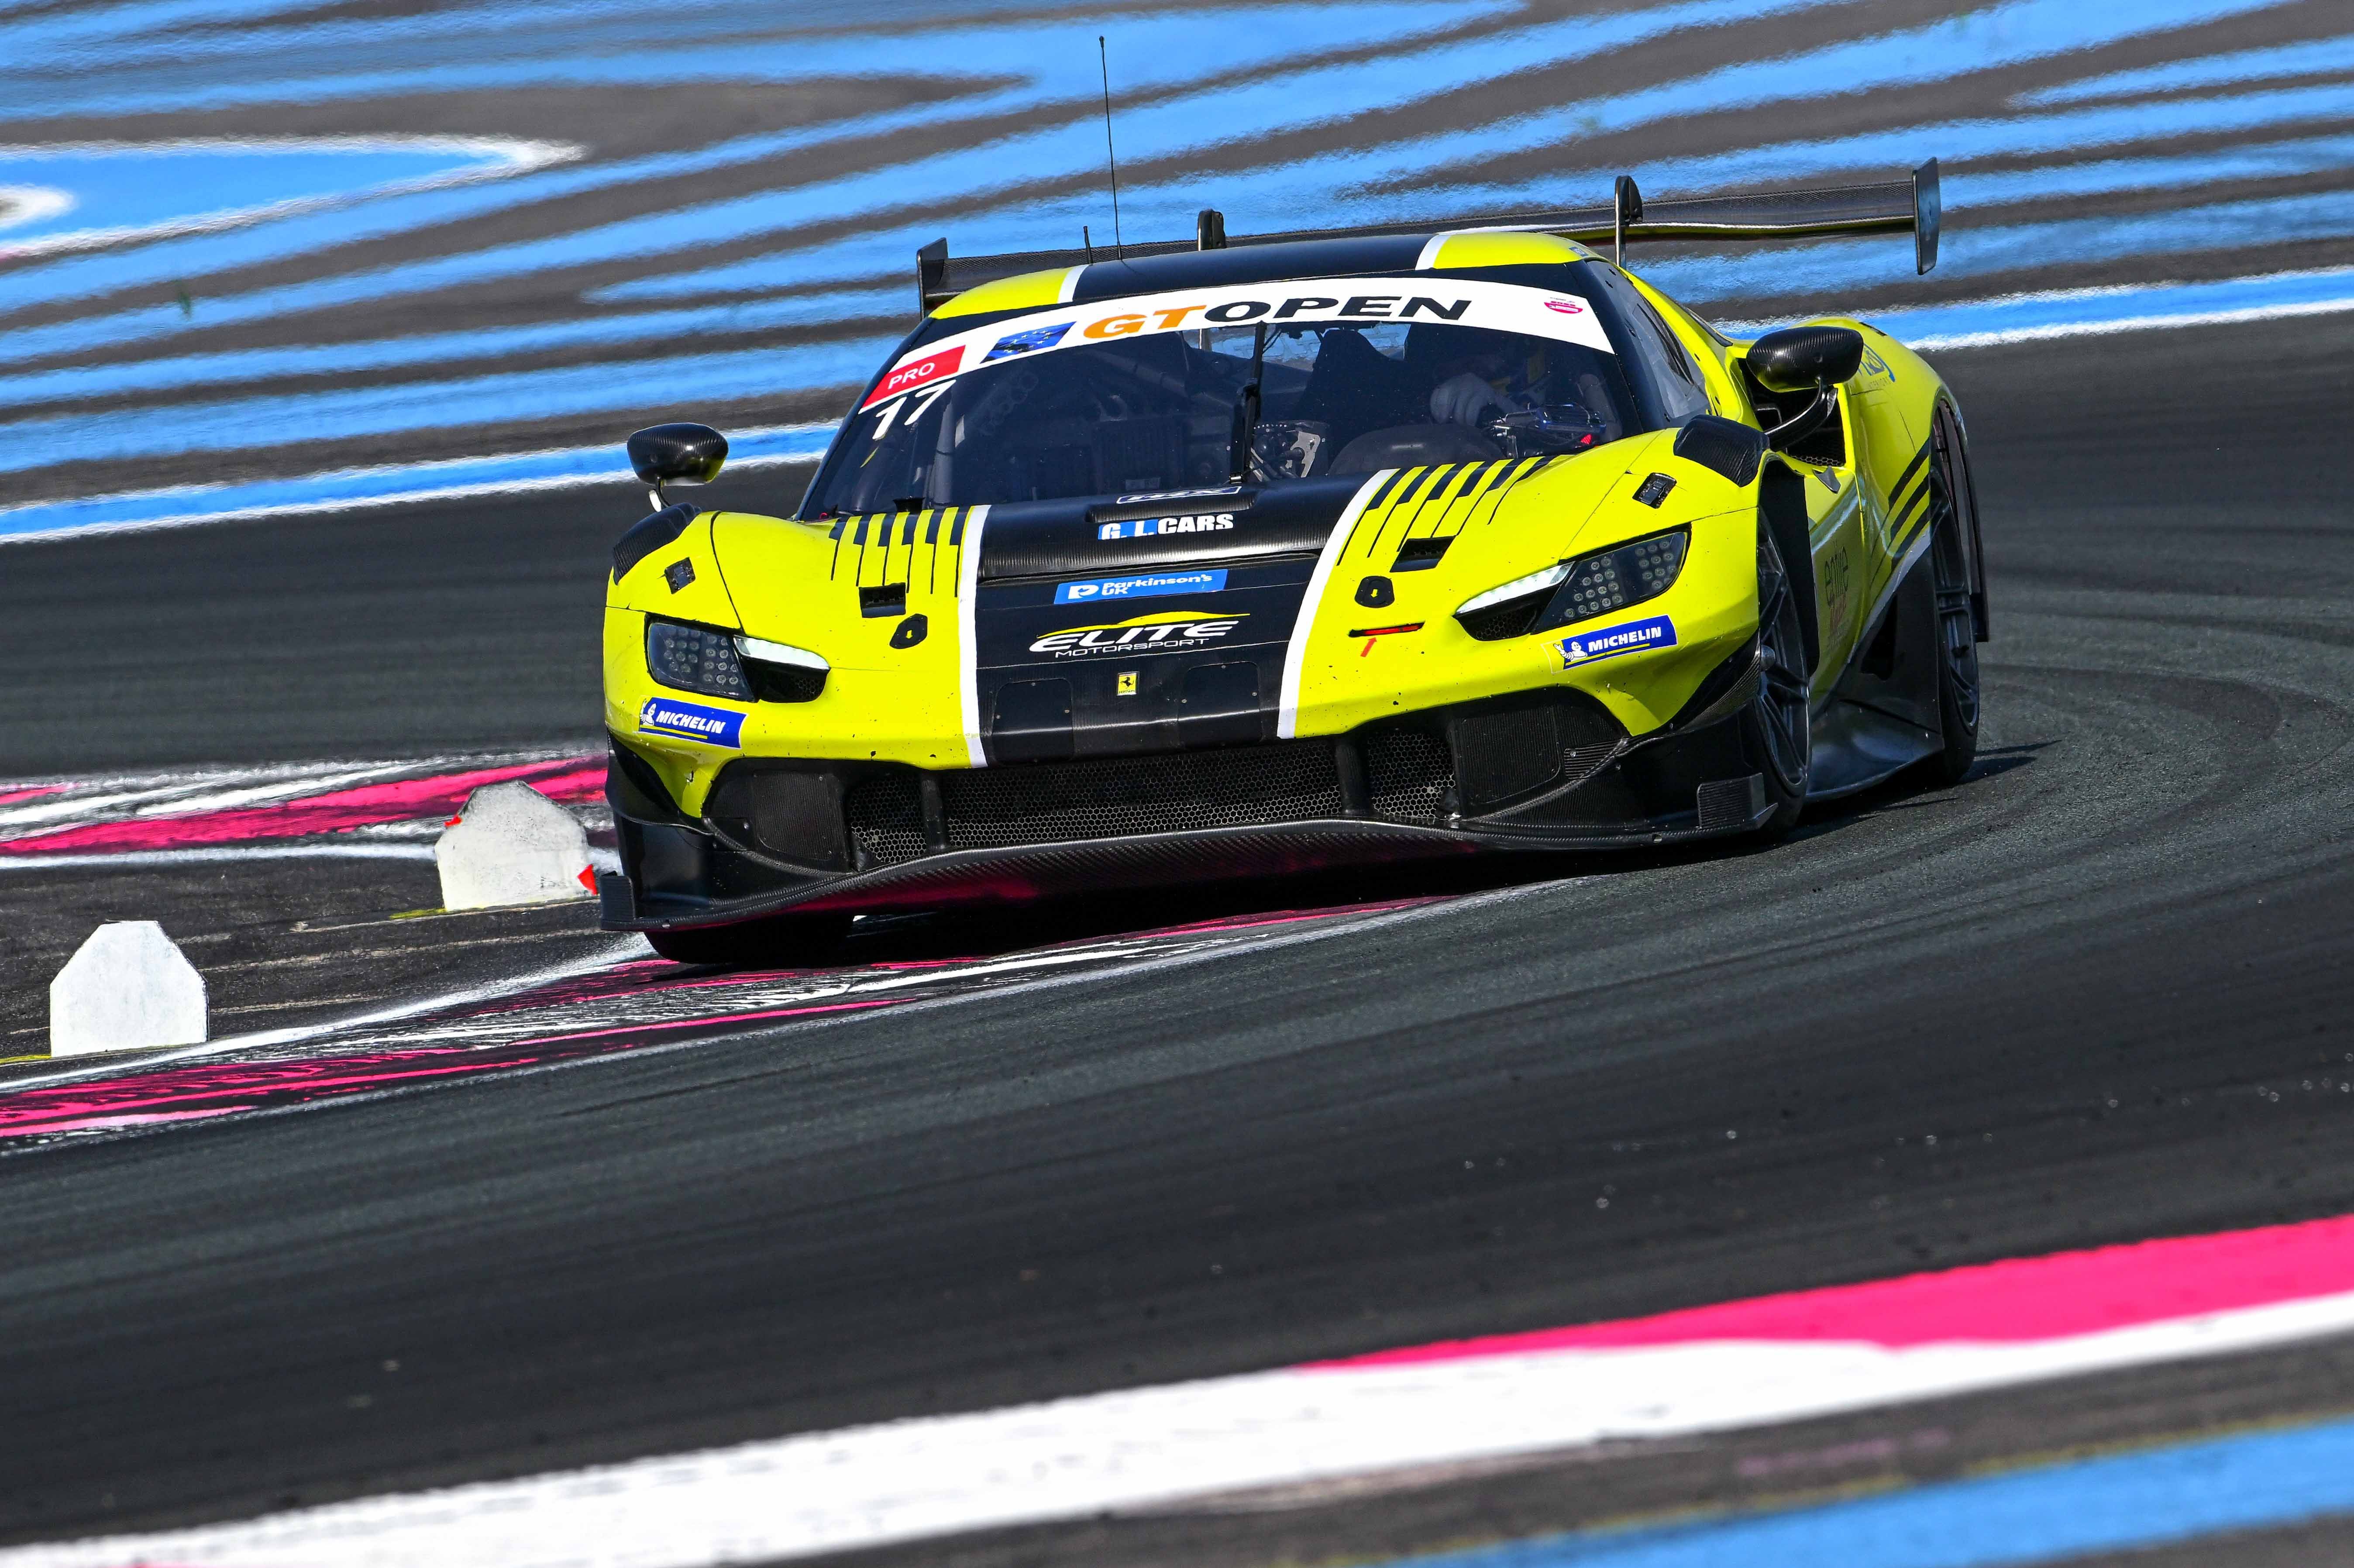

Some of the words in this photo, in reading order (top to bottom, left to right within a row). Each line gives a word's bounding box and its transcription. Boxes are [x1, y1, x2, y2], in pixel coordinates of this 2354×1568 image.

[888, 362, 935, 389] PRO
[872, 379, 957, 440] 17
[1157, 513, 1234, 535] CARS
[1101, 573, 1214, 589] Parkinson's
[1101, 587, 1129, 597] UK
[1029, 620, 1240, 653] ELITE
[1054, 638, 1210, 659] MOTORSPORT
[1588, 626, 1662, 653] MICHELIN
[655, 710, 726, 734] MICHELIN
